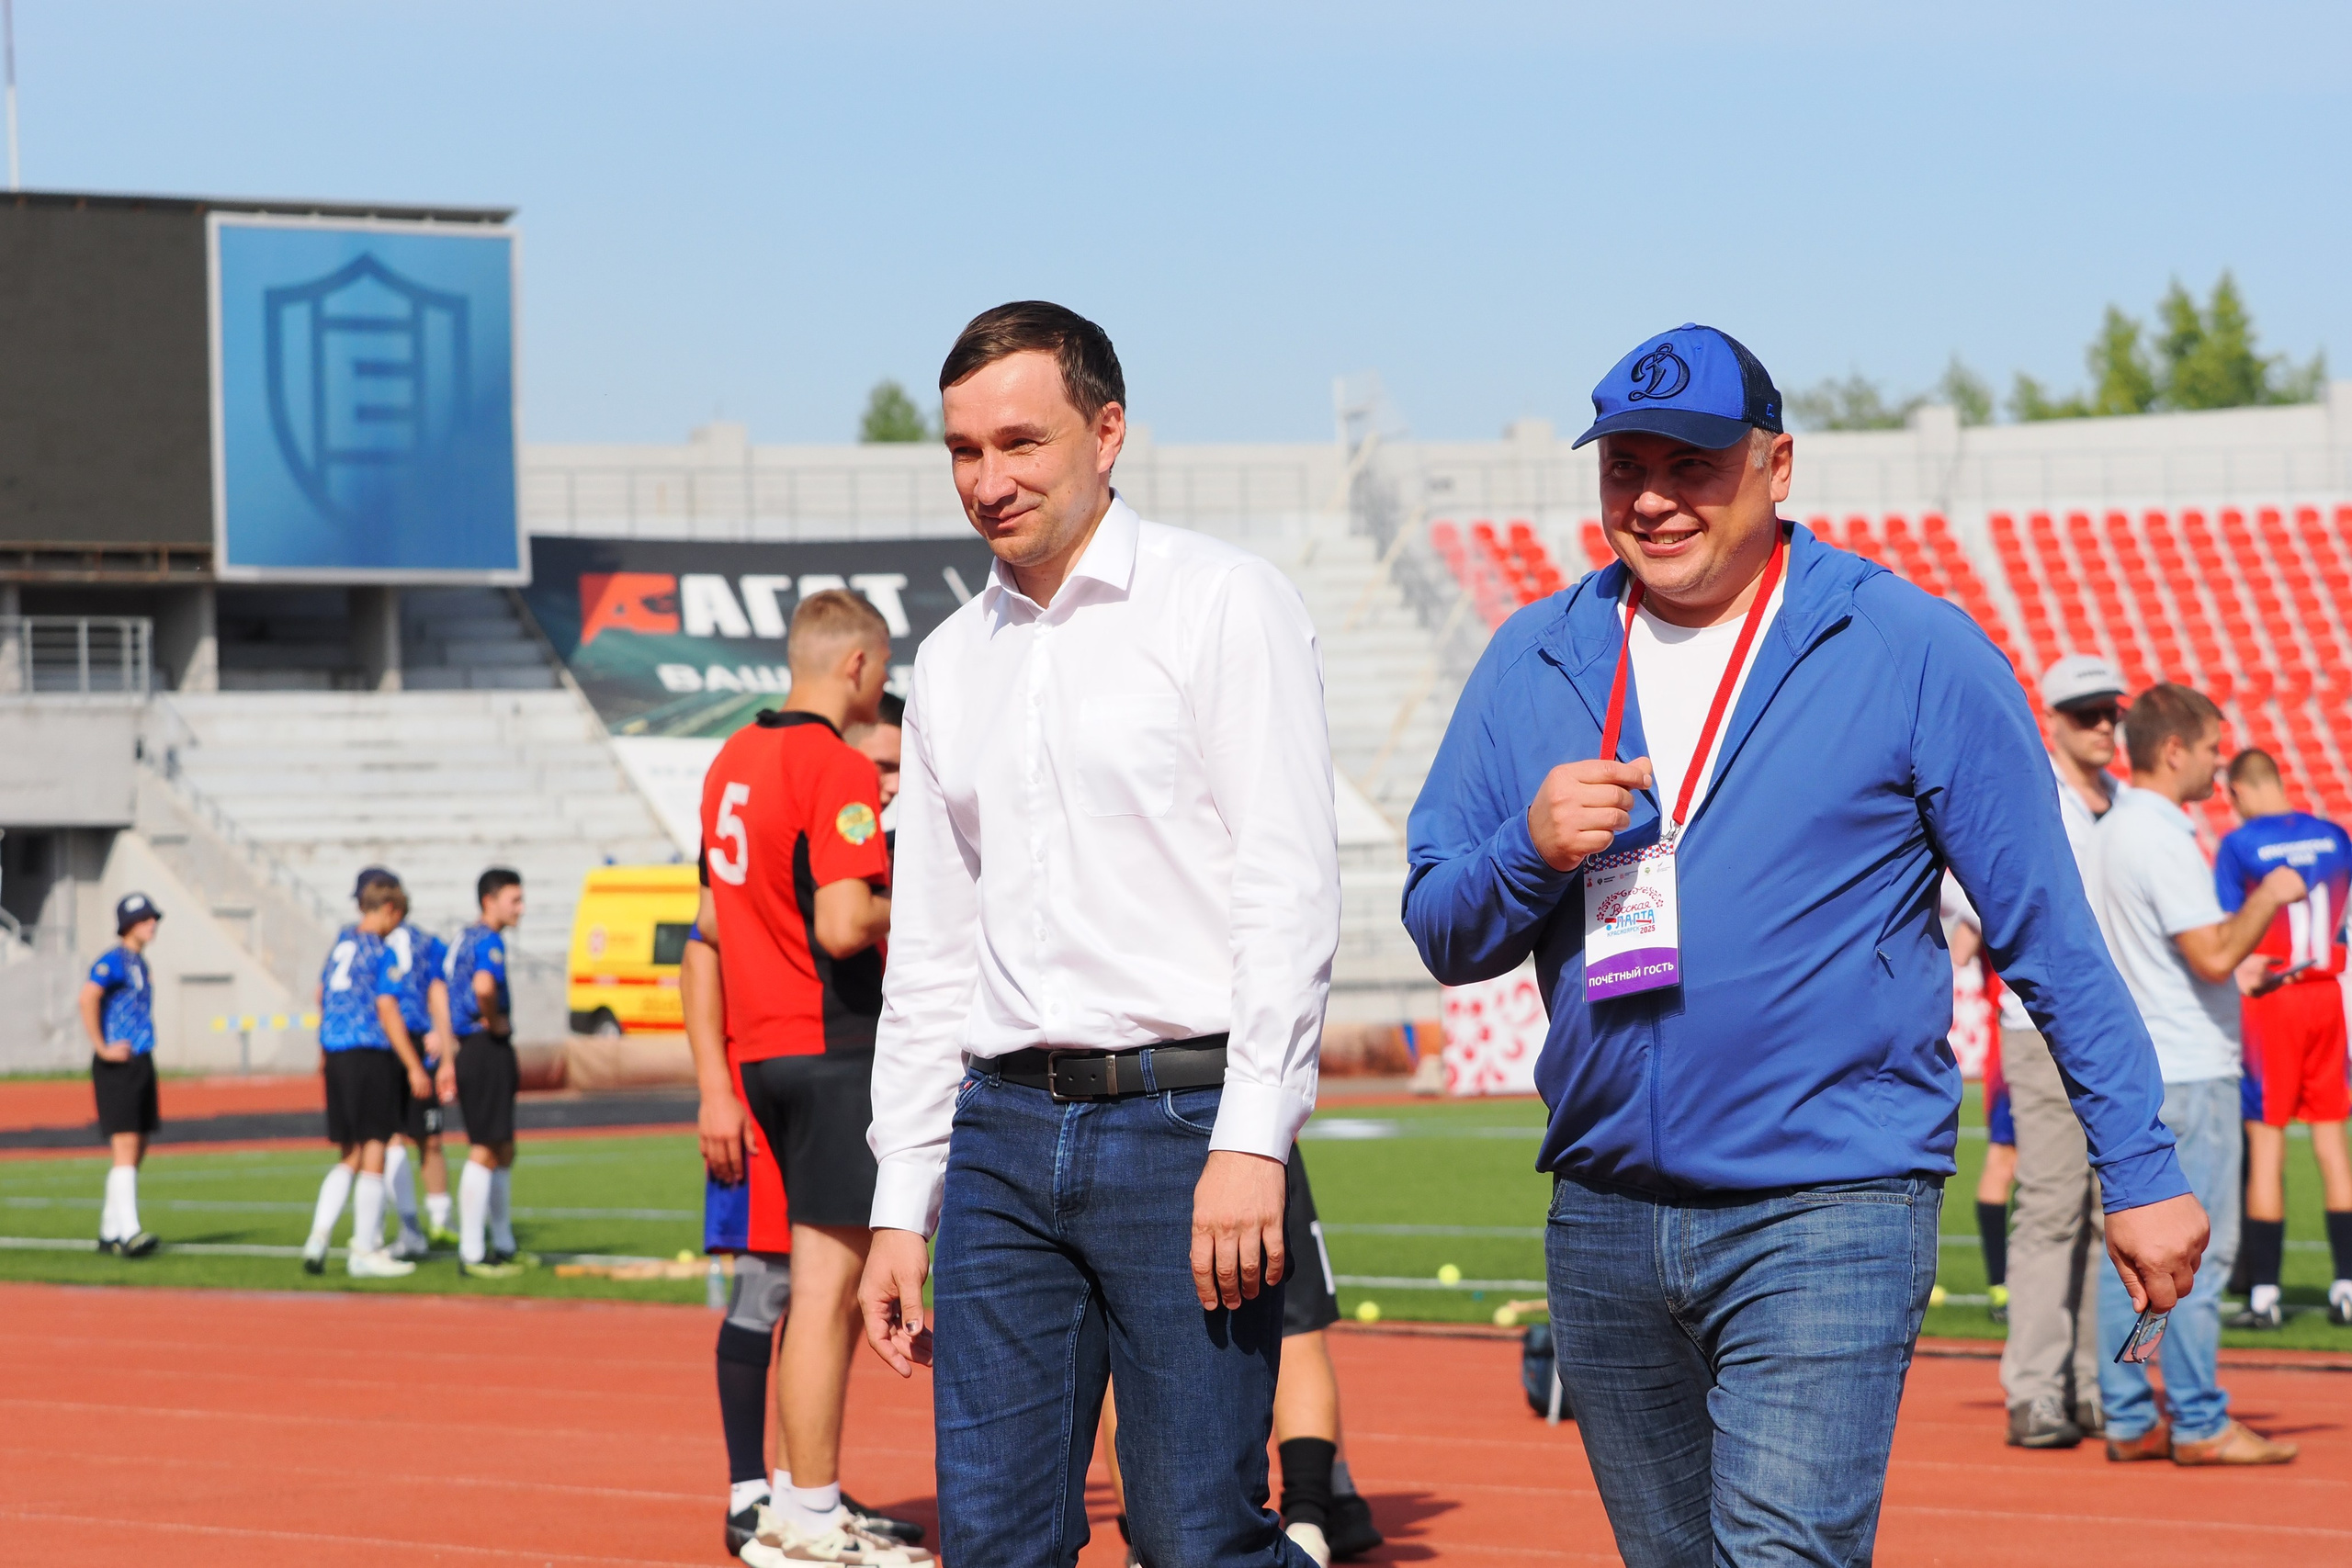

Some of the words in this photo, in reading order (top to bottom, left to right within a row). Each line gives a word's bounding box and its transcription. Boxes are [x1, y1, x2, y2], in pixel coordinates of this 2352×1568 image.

[681, 572, 911, 638] АГТ
[708, 782, 750, 886] 5
[1607, 926, 1640, 937] КРАСНОЯРСК
[1640, 925, 1656, 934] 2025
[1615, 909, 1655, 929] ЛАПТА
[1589, 966, 1642, 987] ПОЧЁТНЫЙ
[1644, 962, 1674, 976] ГОСТЬ
